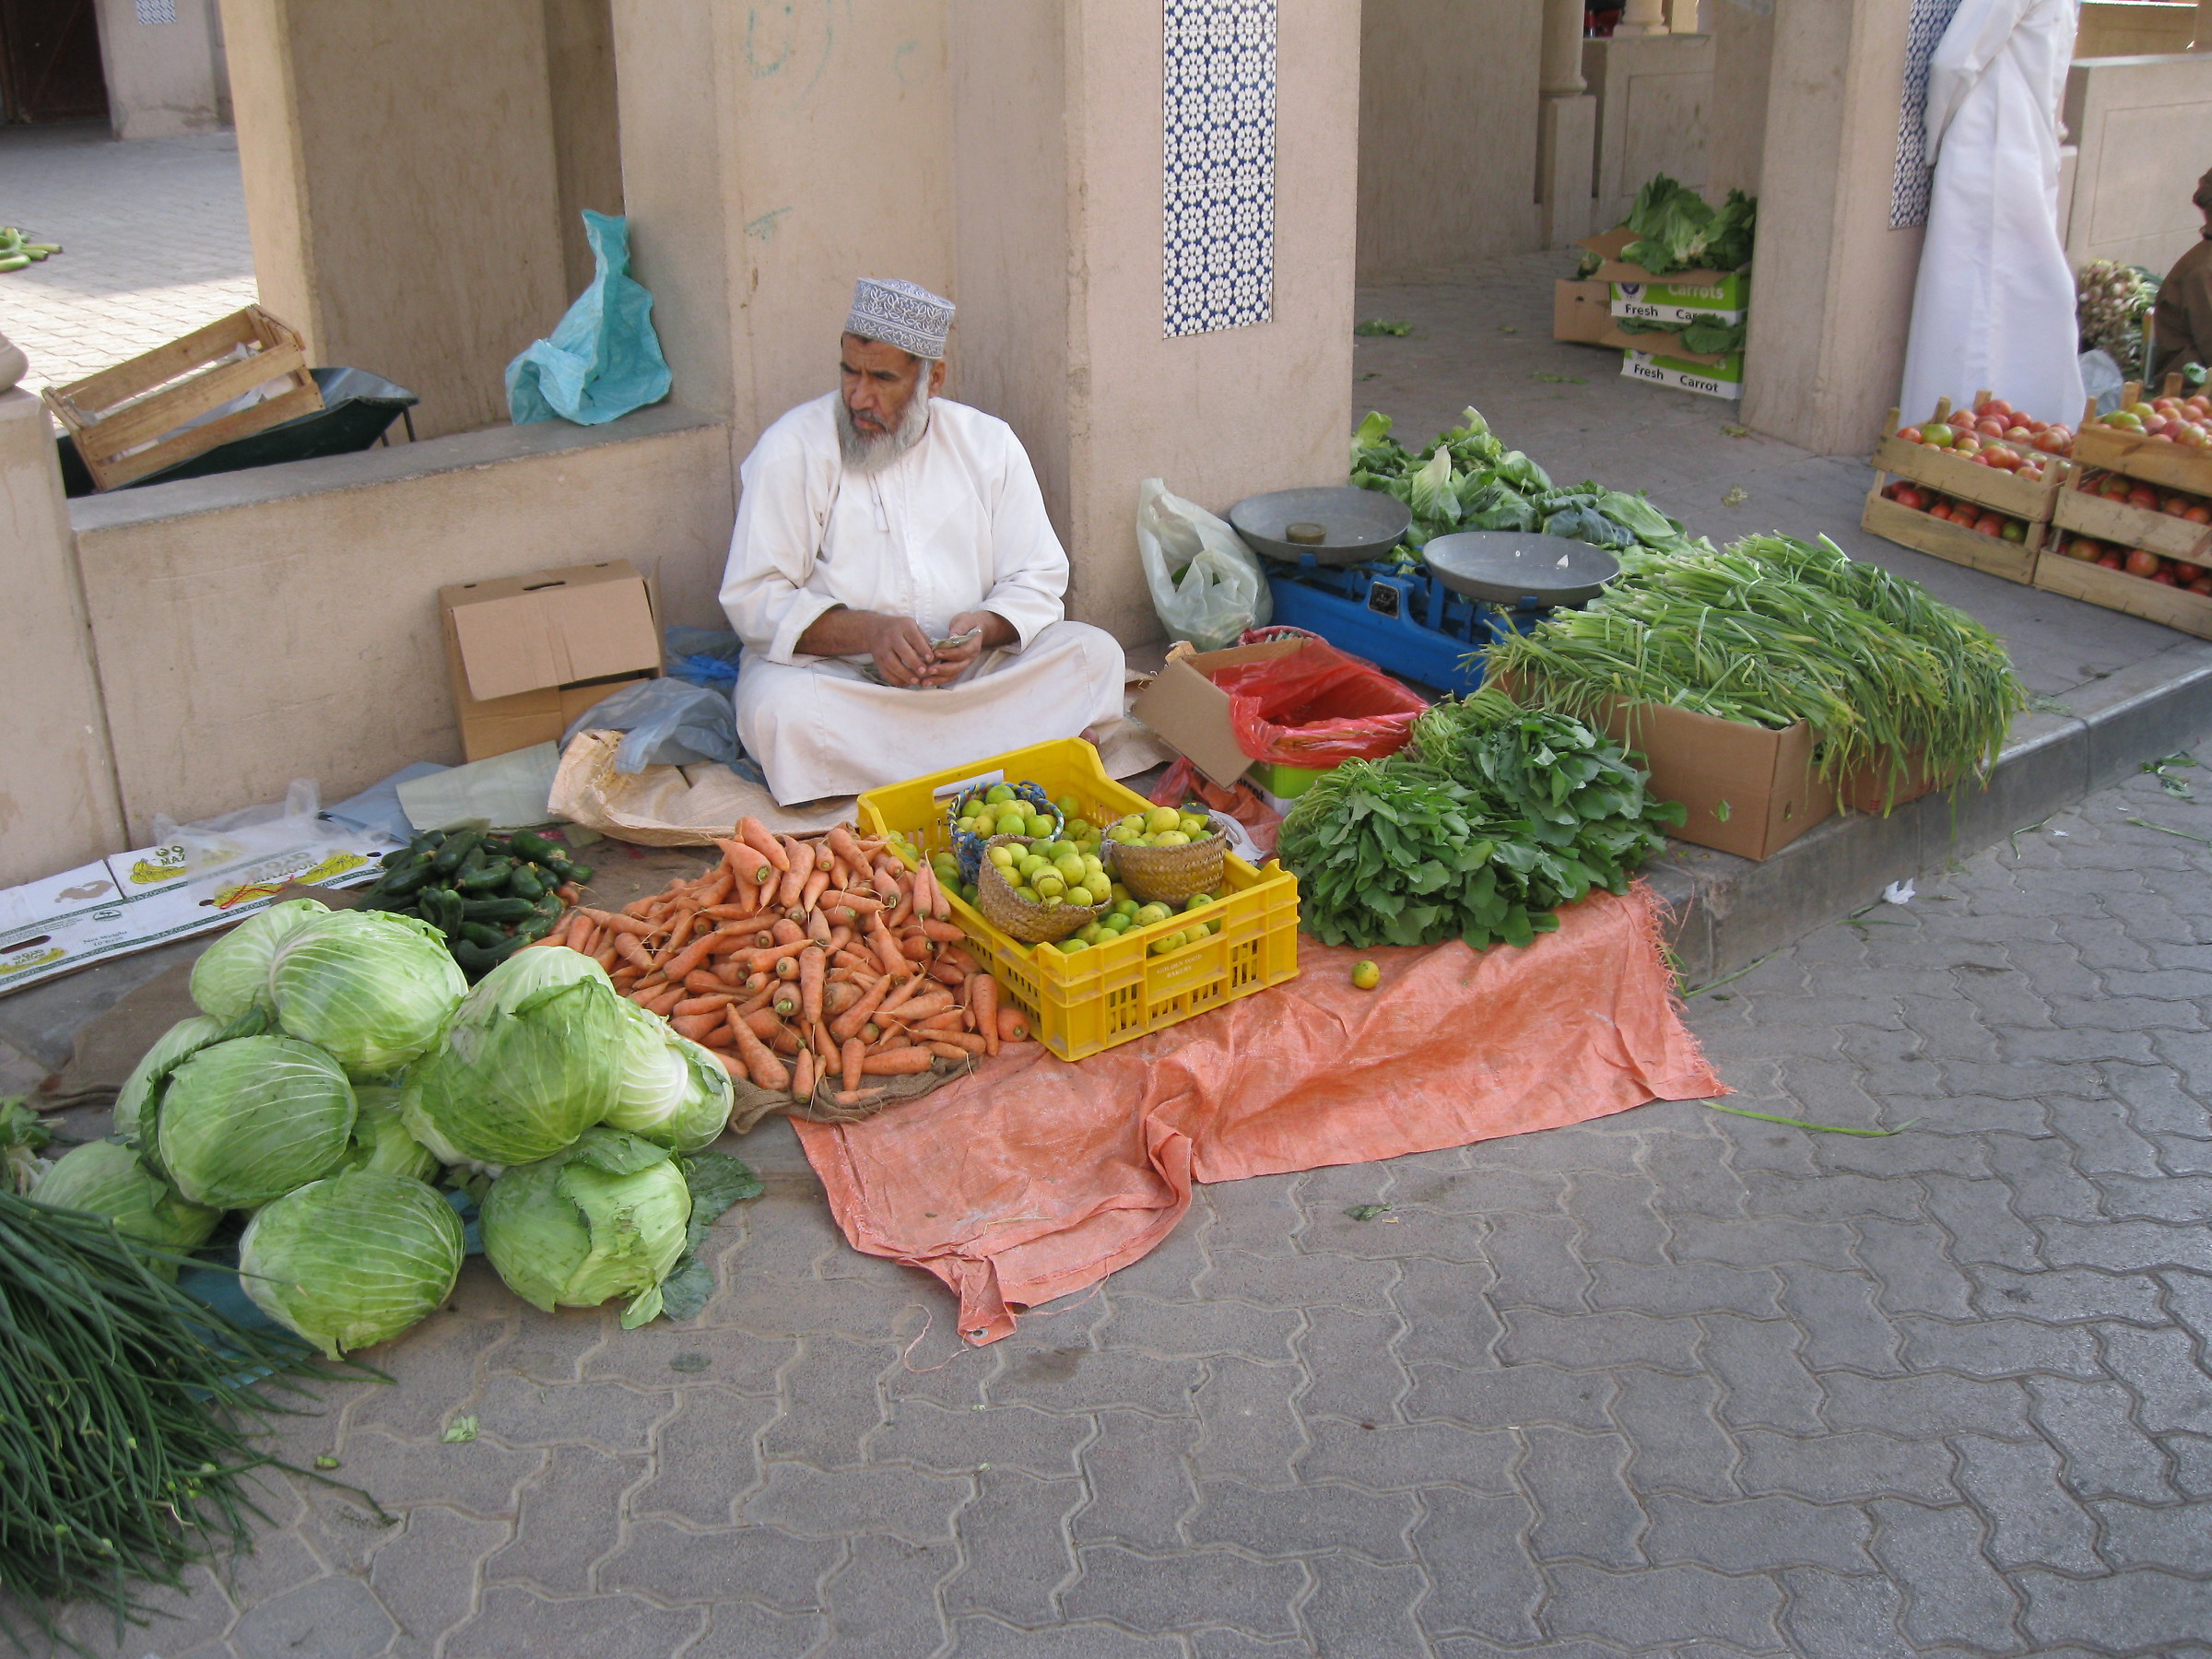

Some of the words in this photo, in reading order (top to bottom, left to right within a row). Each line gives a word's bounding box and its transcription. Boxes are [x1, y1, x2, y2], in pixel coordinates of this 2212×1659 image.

[1667, 283, 1724, 300] Carrots
[1625, 304, 1658, 317] Fresh
[1634, 363, 1664, 381] Fresh
[1680, 374, 1719, 393] Carrot
[317, 877, 344, 889] ZOON
[229, 900, 270, 915] MAZOON
[1157, 960, 1183, 973] GOLDEN
[1166, 965, 1192, 978] BAKERY
